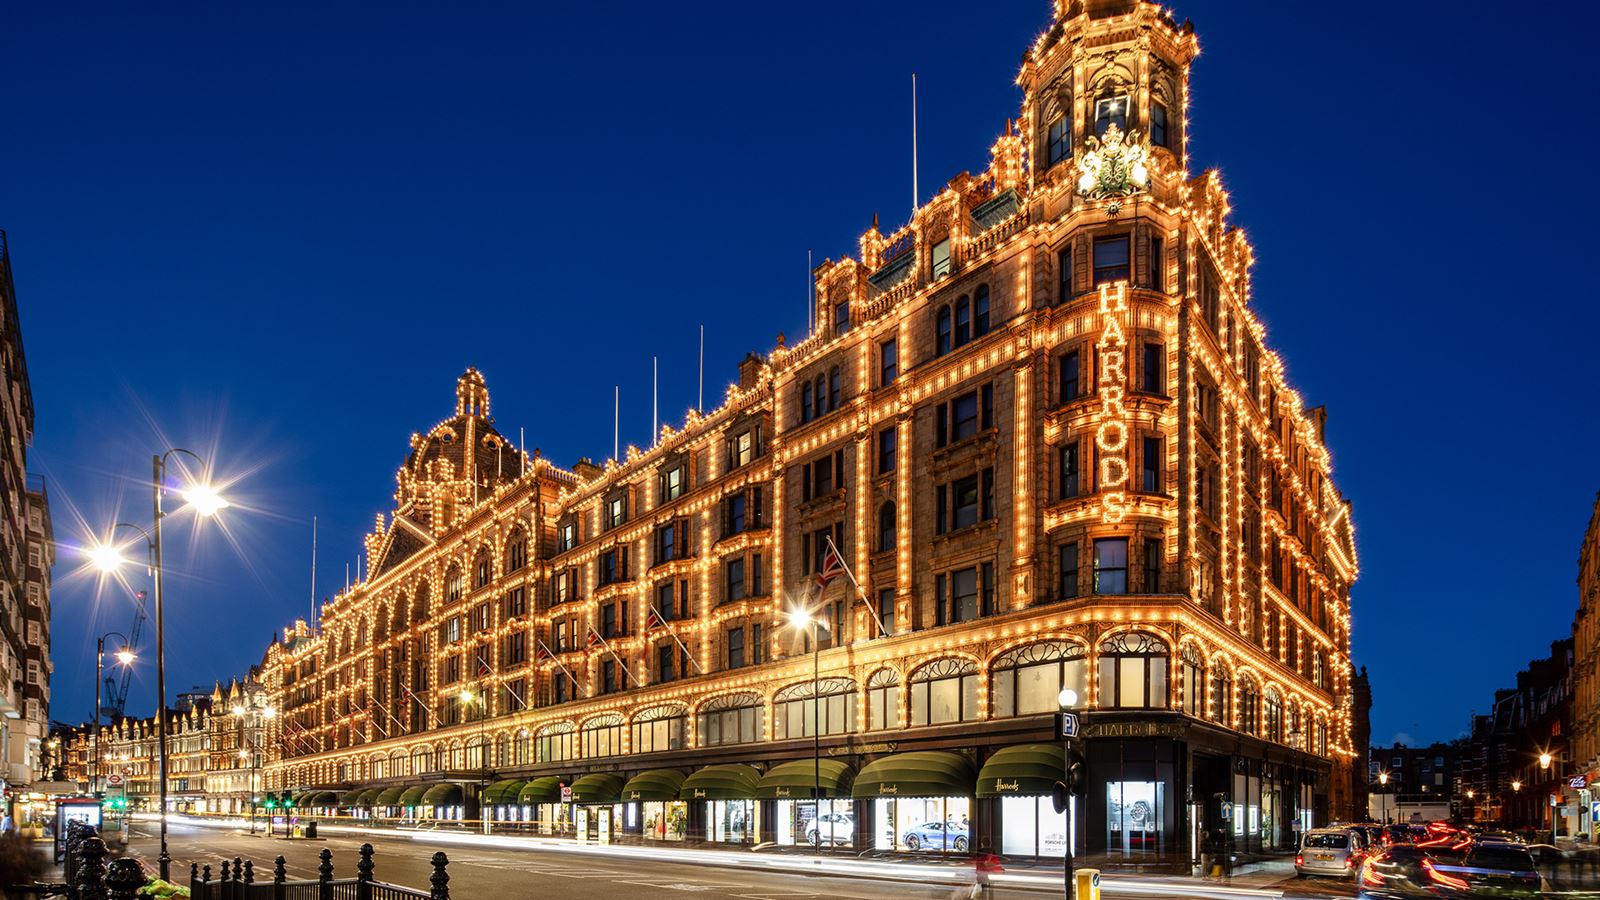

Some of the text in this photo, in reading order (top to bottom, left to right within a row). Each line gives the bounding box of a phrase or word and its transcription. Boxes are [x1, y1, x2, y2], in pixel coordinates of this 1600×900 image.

[1096, 280, 1129, 524] HARRODS
[1064, 716, 1071, 733] P
[995, 778, 1019, 792] Harrods
